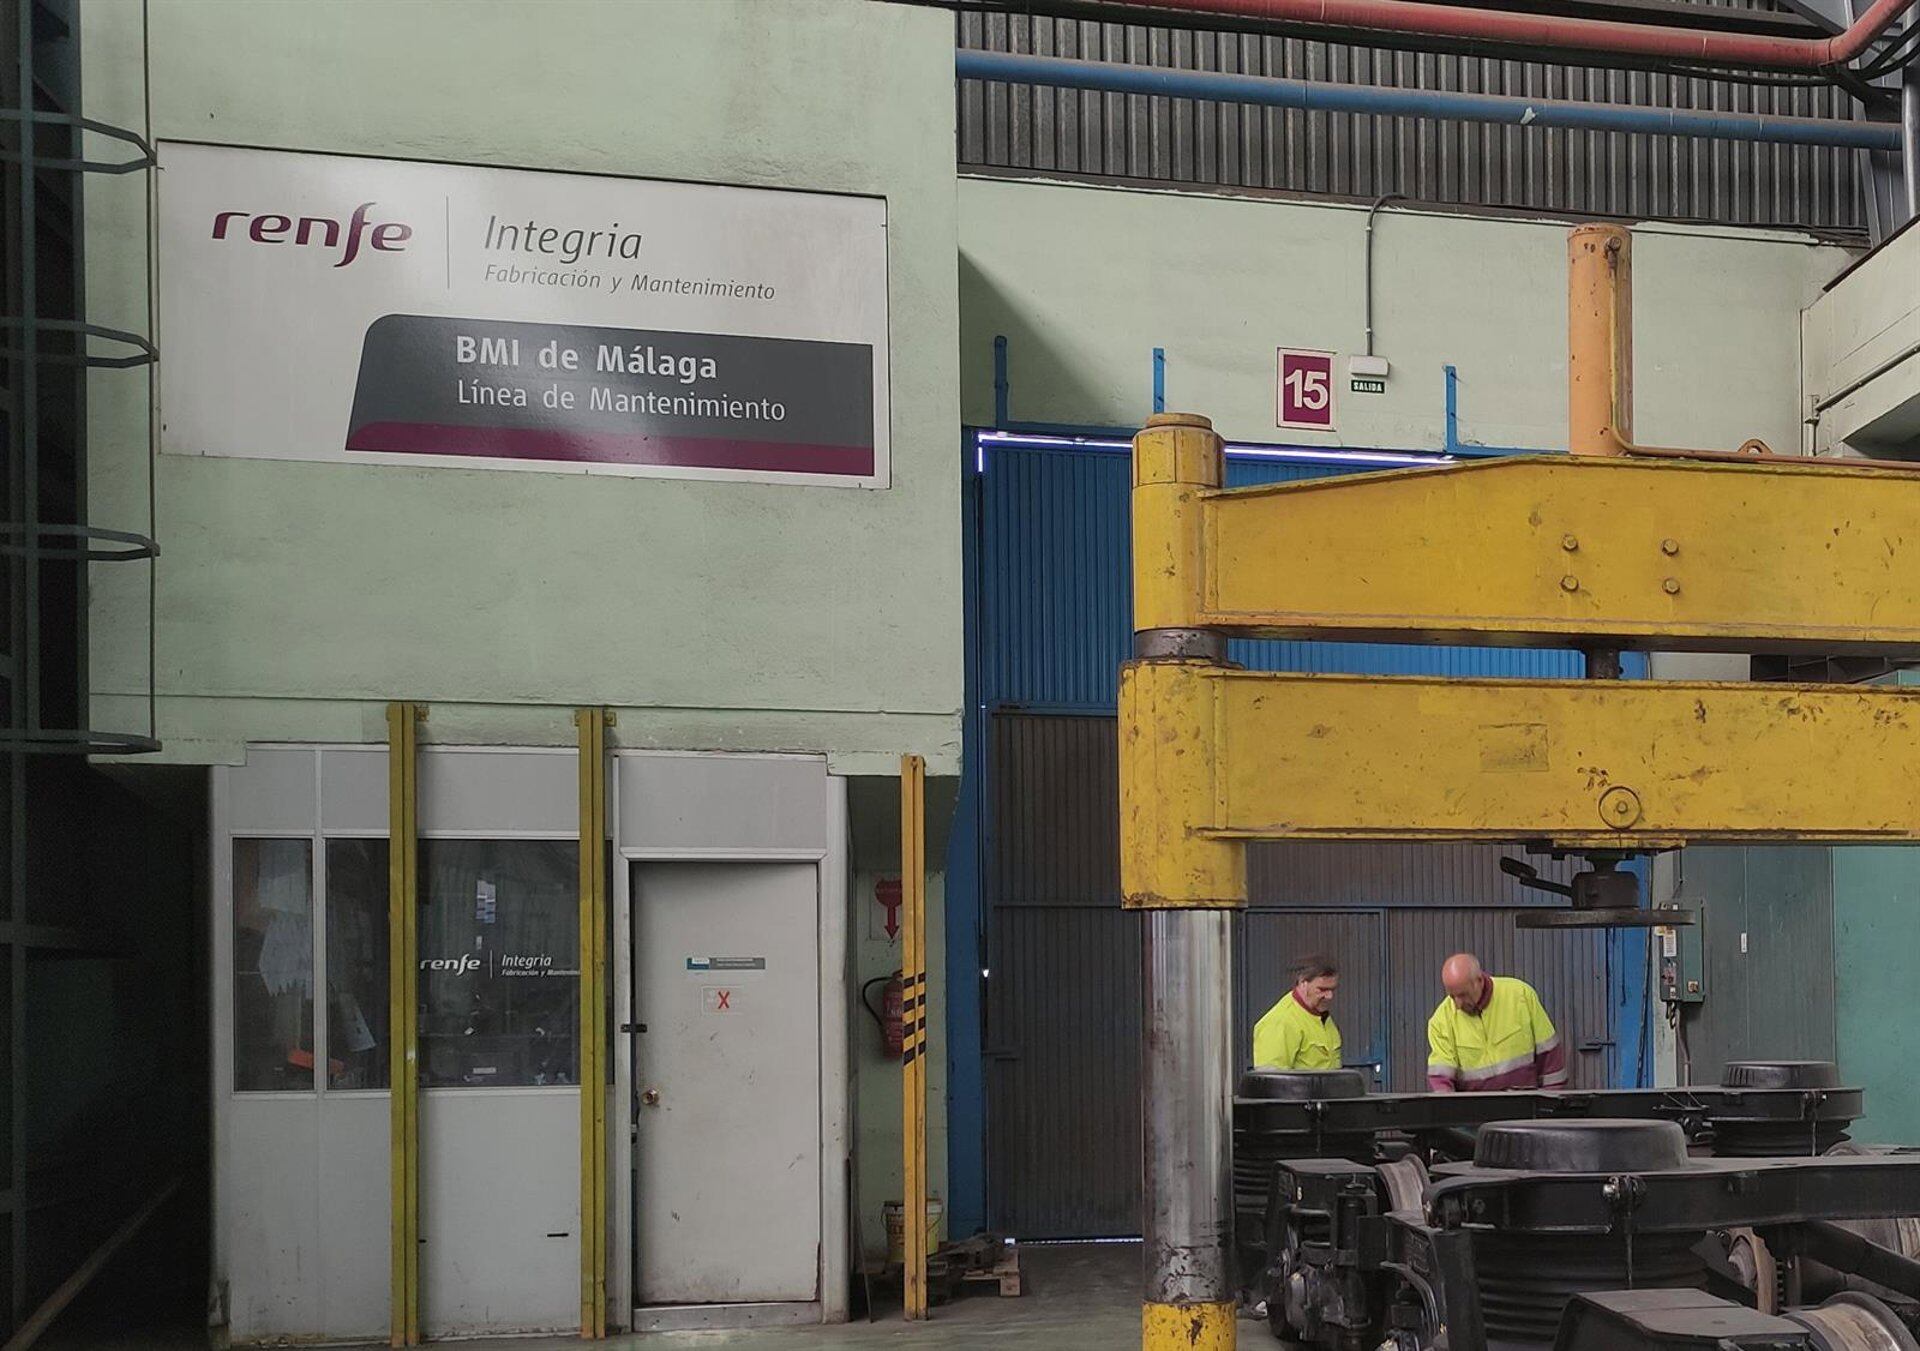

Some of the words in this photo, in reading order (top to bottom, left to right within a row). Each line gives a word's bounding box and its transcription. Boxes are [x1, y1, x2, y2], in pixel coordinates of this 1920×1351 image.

[212, 201, 413, 268] renfe
[485, 215, 643, 264] Integria
[485, 264, 600, 288] Fabricación
[610, 274, 623, 294] y
[630, 273, 776, 300] Mantenimiento
[456, 335, 519, 366] BMI
[539, 340, 579, 371] de
[597, 345, 718, 384] Málaga
[458, 378, 527, 407] Línea
[543, 384, 575, 409] de
[590, 386, 786, 421] Mantenimiento
[1285, 369, 1329, 410] 15
[1353, 381, 1383, 392] SALIDA
[420, 953, 481, 976] renfe
[502, 953, 552, 970] Integria
